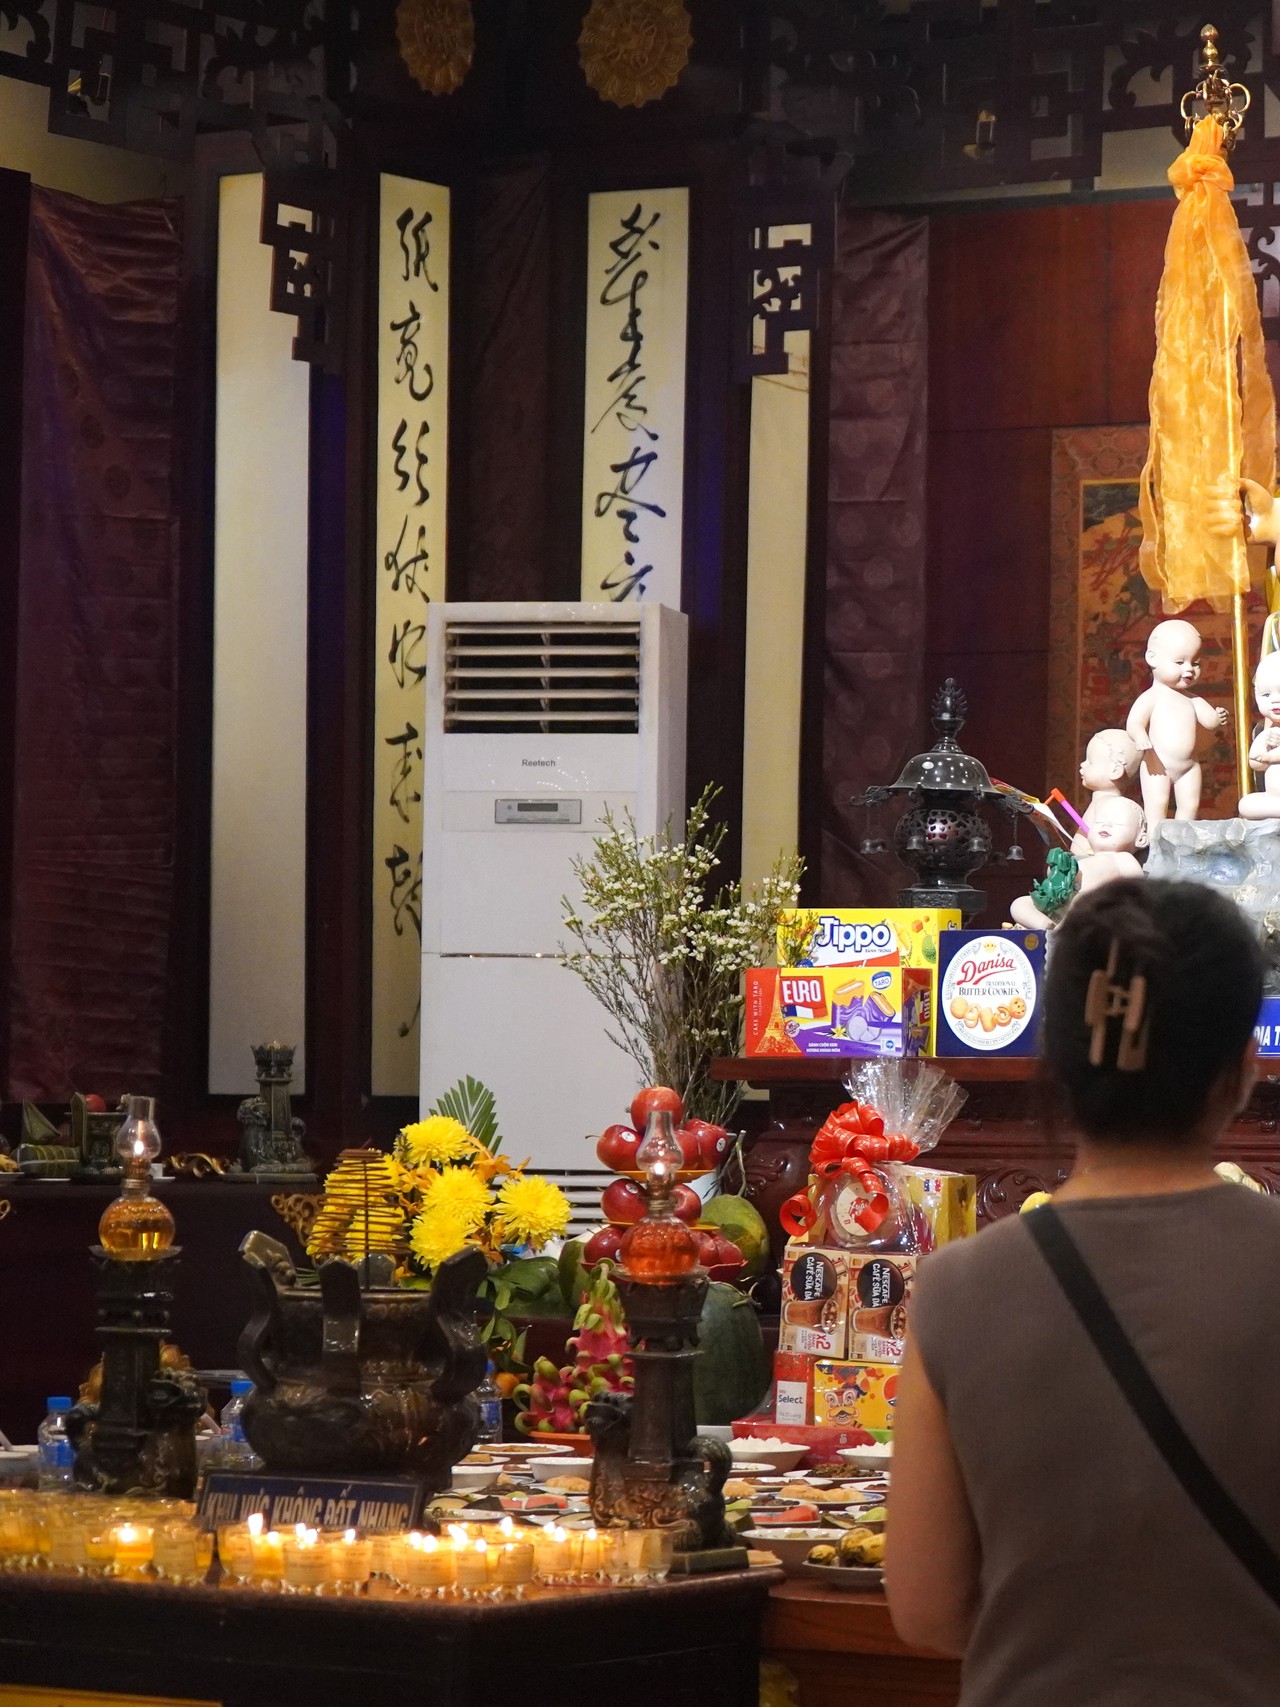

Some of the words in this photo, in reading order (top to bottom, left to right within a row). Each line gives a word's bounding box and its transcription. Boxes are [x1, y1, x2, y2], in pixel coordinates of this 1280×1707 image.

[521, 759, 556, 767] Reetech
[817, 916, 890, 952] Jippo
[956, 953, 1017, 986] Danisa
[874, 976, 890, 987] TARO
[781, 979, 821, 1003] EURO
[959, 987, 987, 996] BUTTER
[987, 987, 1020, 996] COOKIES
[805, 1256, 815, 1275] CAFÉ
[872, 1263, 882, 1281] CAFÉ
[778, 1394, 803, 1404] Select
[271, 1487, 323, 1525] KHÔNG
